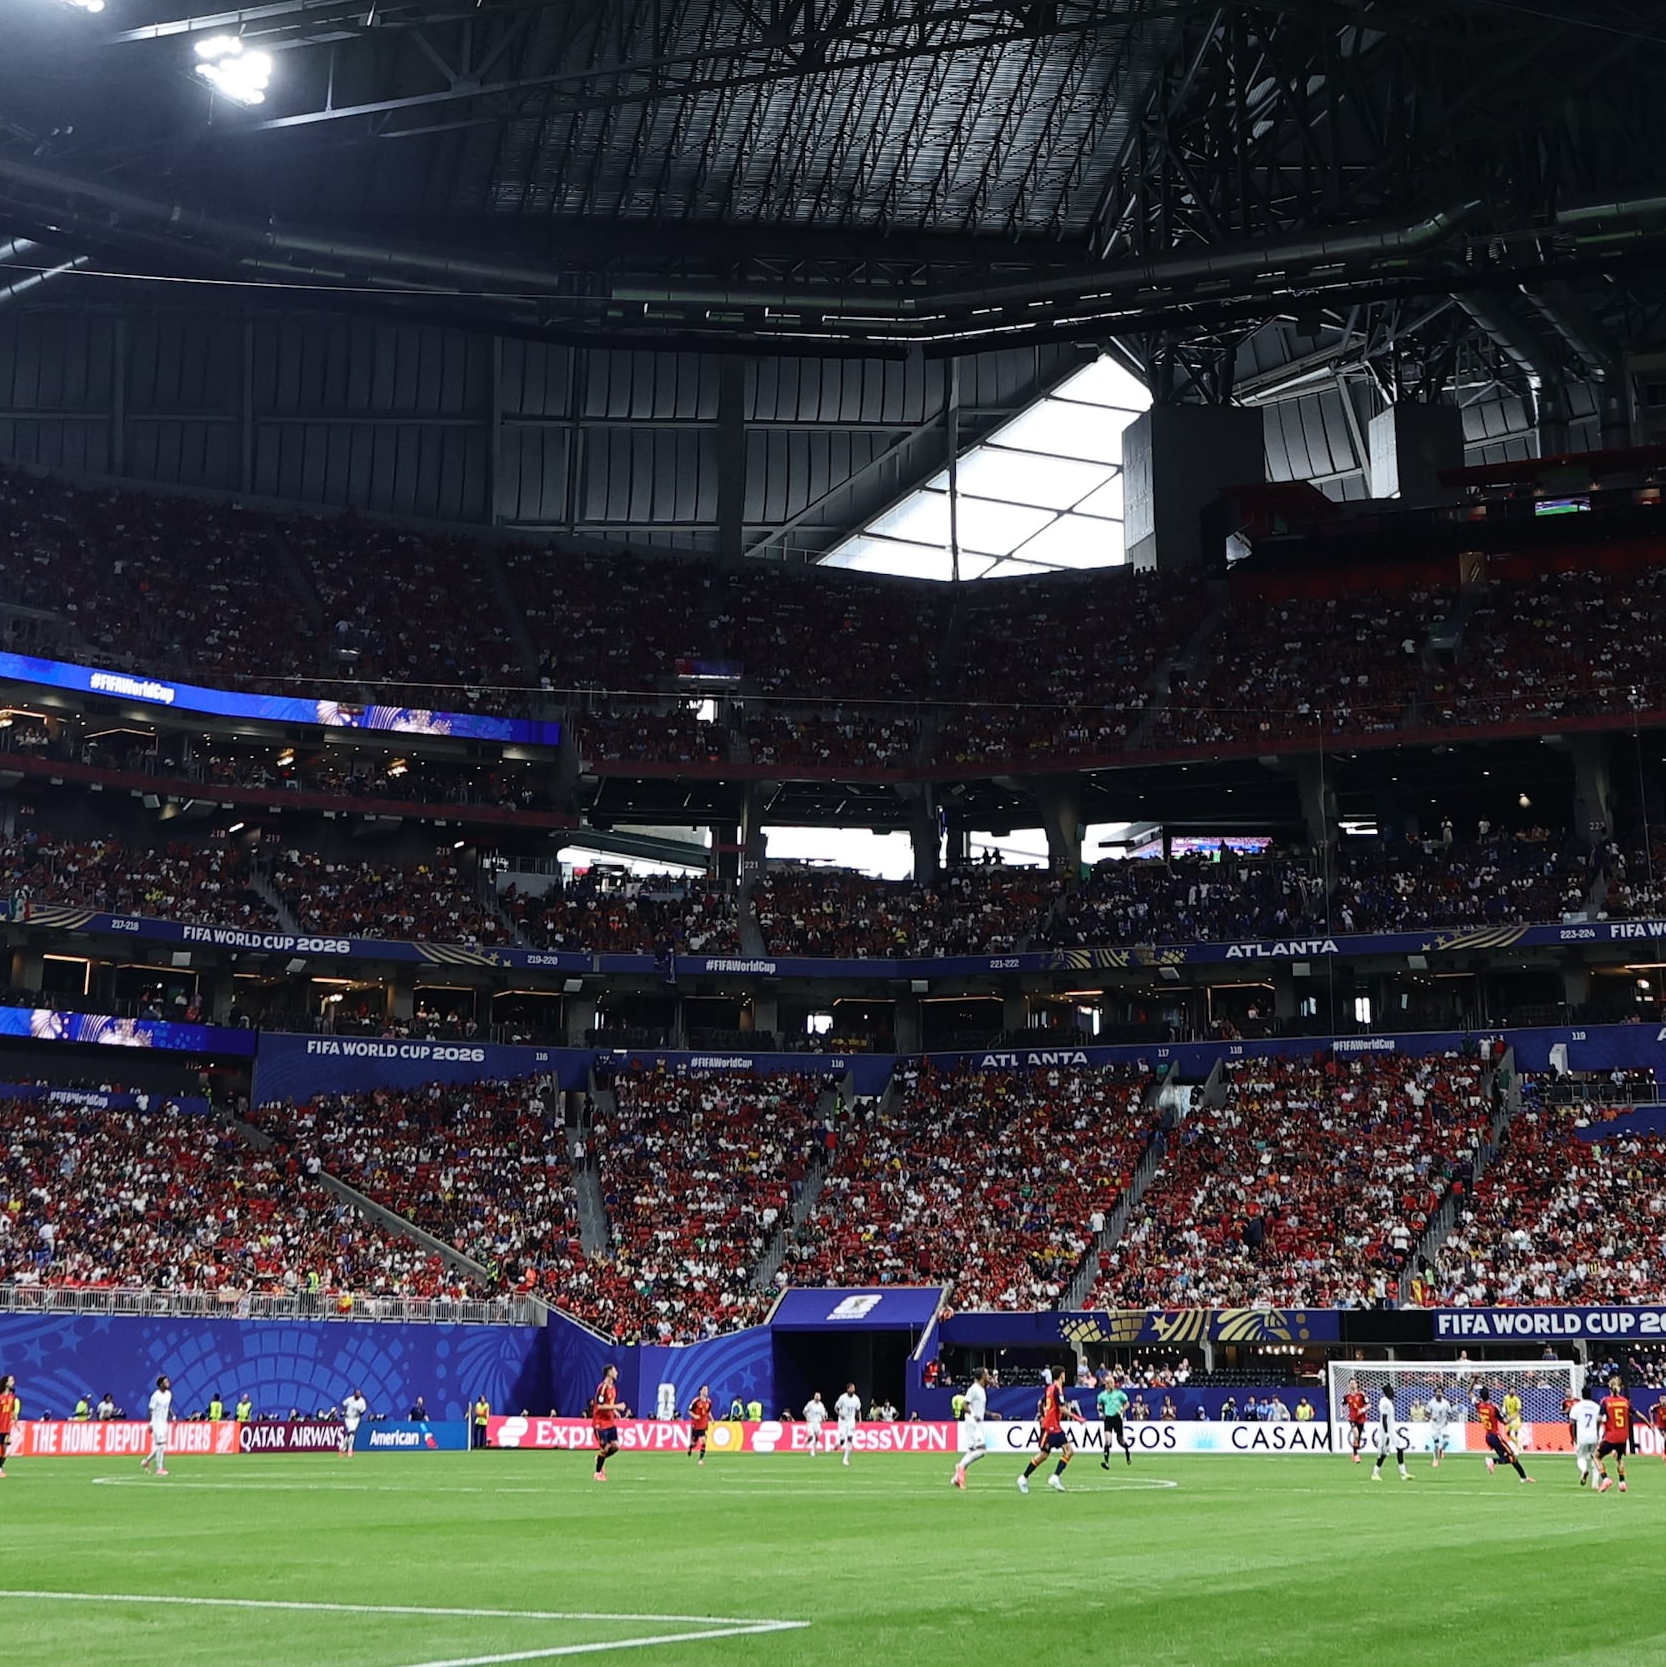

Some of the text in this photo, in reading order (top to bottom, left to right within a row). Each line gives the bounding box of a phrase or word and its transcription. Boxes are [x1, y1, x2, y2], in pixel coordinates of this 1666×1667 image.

[90, 672, 175, 705] #FIFAWorldCup
[182, 926, 351, 954] FIFA WORLD CUP 2026
[1610, 924, 1646, 939] FIFA
[1225, 940, 1339, 959] ATLANTA
[705, 960, 776, 974] #FIFAWorldCup
[307, 1040, 485, 1062] FIFA WORLD CUP 2026
[1439, 1313, 1489, 1334] FIFA
[1493, 1313, 1584, 1334] WORLD
[1586, 1313, 1635, 1334] CUP
[1585, 1413, 1593, 1428] 7
[1614, 1408, 1624, 1427] 5
[31, 1423, 151, 1454] THE HOME DEPOT
[240, 1427, 286, 1453] QATAR
[289, 1425, 345, 1449] AIRWAYS
[370, 1429, 420, 1448] American
